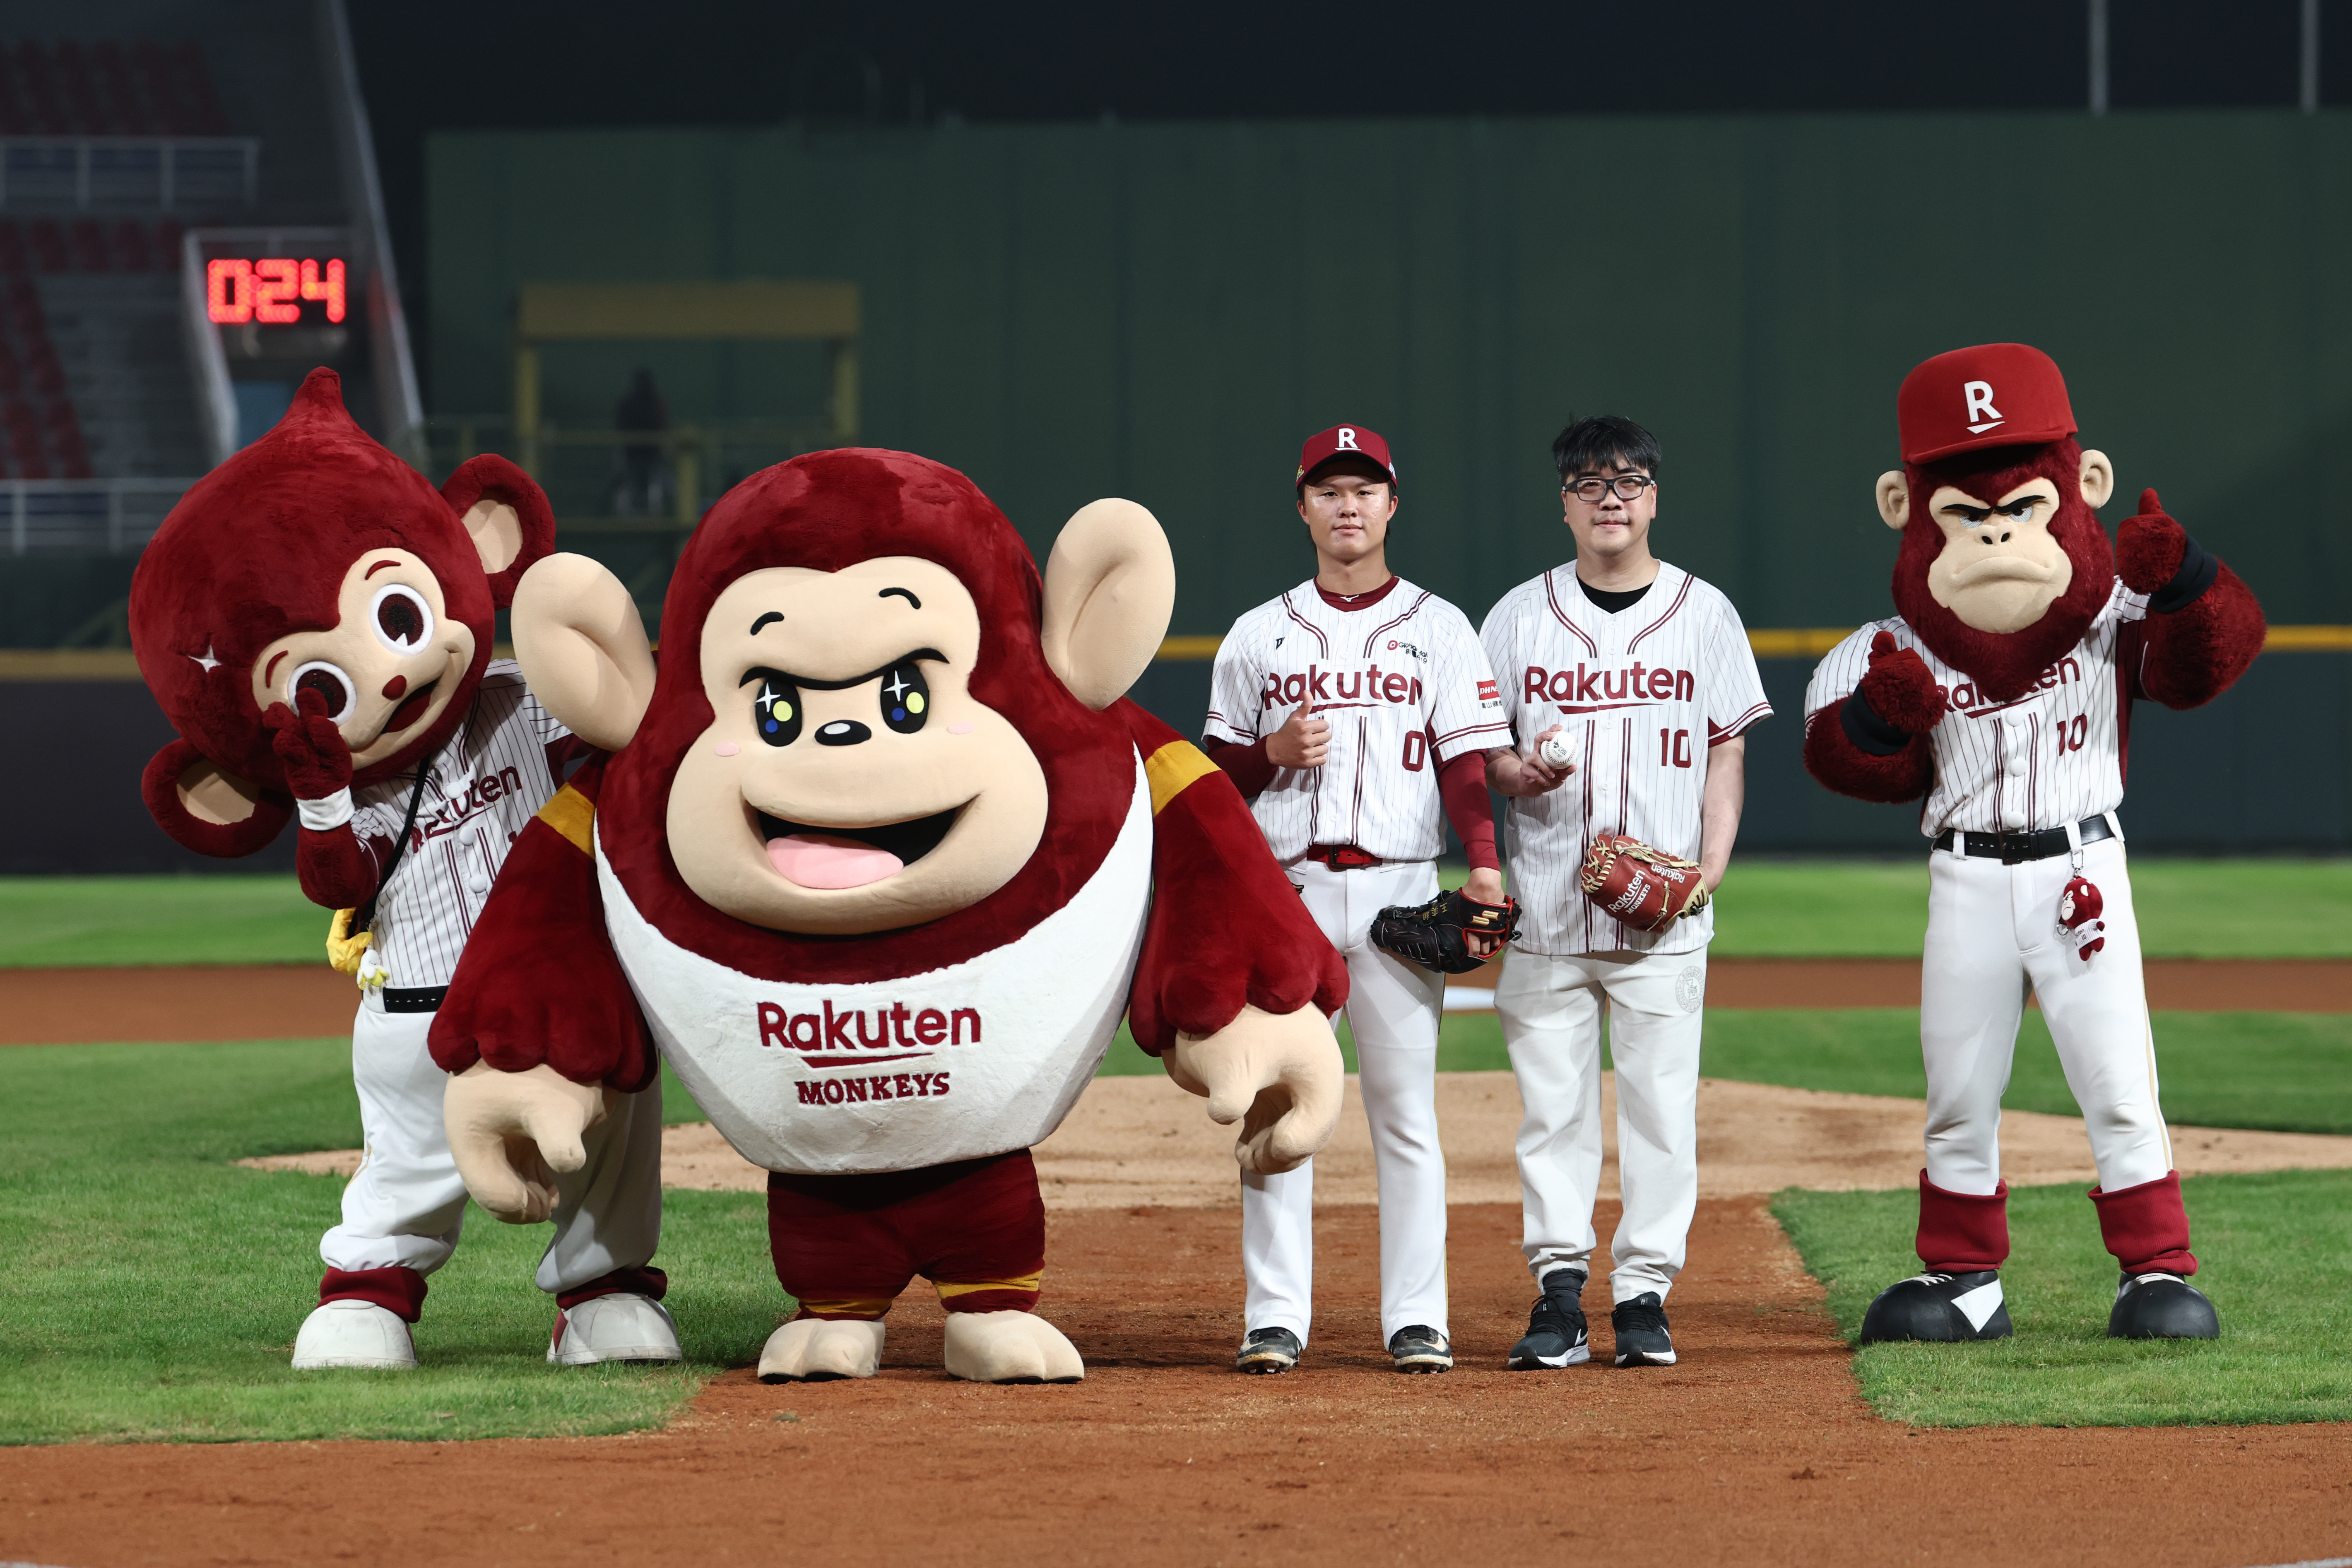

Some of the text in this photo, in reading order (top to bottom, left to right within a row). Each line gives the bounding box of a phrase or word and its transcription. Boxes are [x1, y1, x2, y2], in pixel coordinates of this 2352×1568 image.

[1964, 380, 2003, 423] R
[1338, 428, 1358, 448] R
[1264, 664, 1422, 711] Rakuten
[1524, 661, 1694, 704] Rakuten
[1934, 657, 2080, 713] Raen
[1402, 730, 1426, 772] 0
[1661, 728, 1692, 768] 10
[2057, 713, 2087, 756] 10
[1607, 870, 1645, 913] Rakuten
[1651, 863, 1685, 884] Rakuten
[1625, 884, 1651, 914] MONKEYS
[757, 1000, 981, 1050] Rakuten
[794, 1072, 950, 1105] MONKEYS
